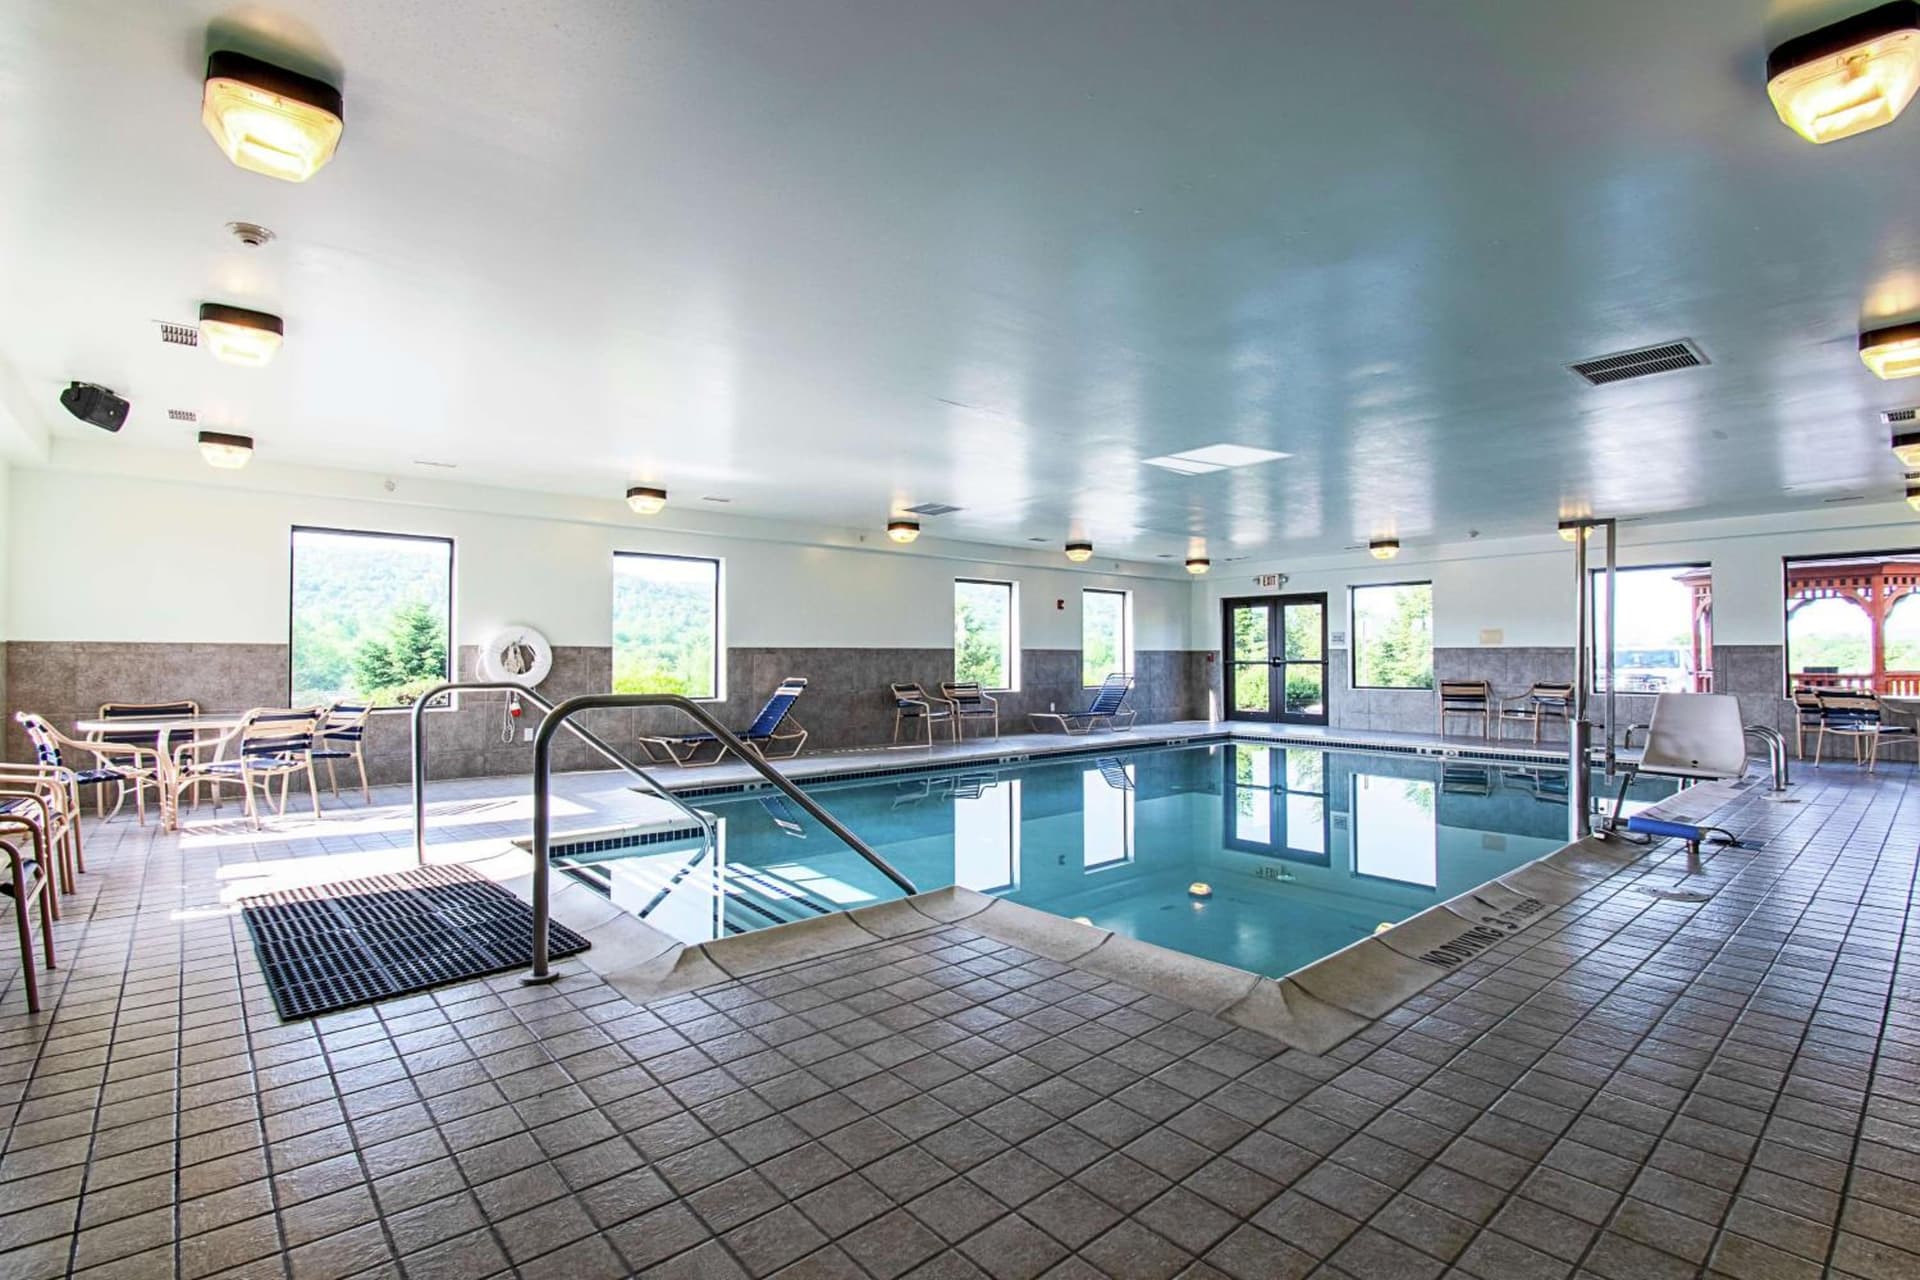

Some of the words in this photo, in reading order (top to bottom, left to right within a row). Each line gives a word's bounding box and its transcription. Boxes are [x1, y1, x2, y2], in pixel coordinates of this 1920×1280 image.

[1262, 575, 1277, 587] EXIT
[1439, 926, 1505, 957] DIVING
[1419, 950, 1463, 969] NO
